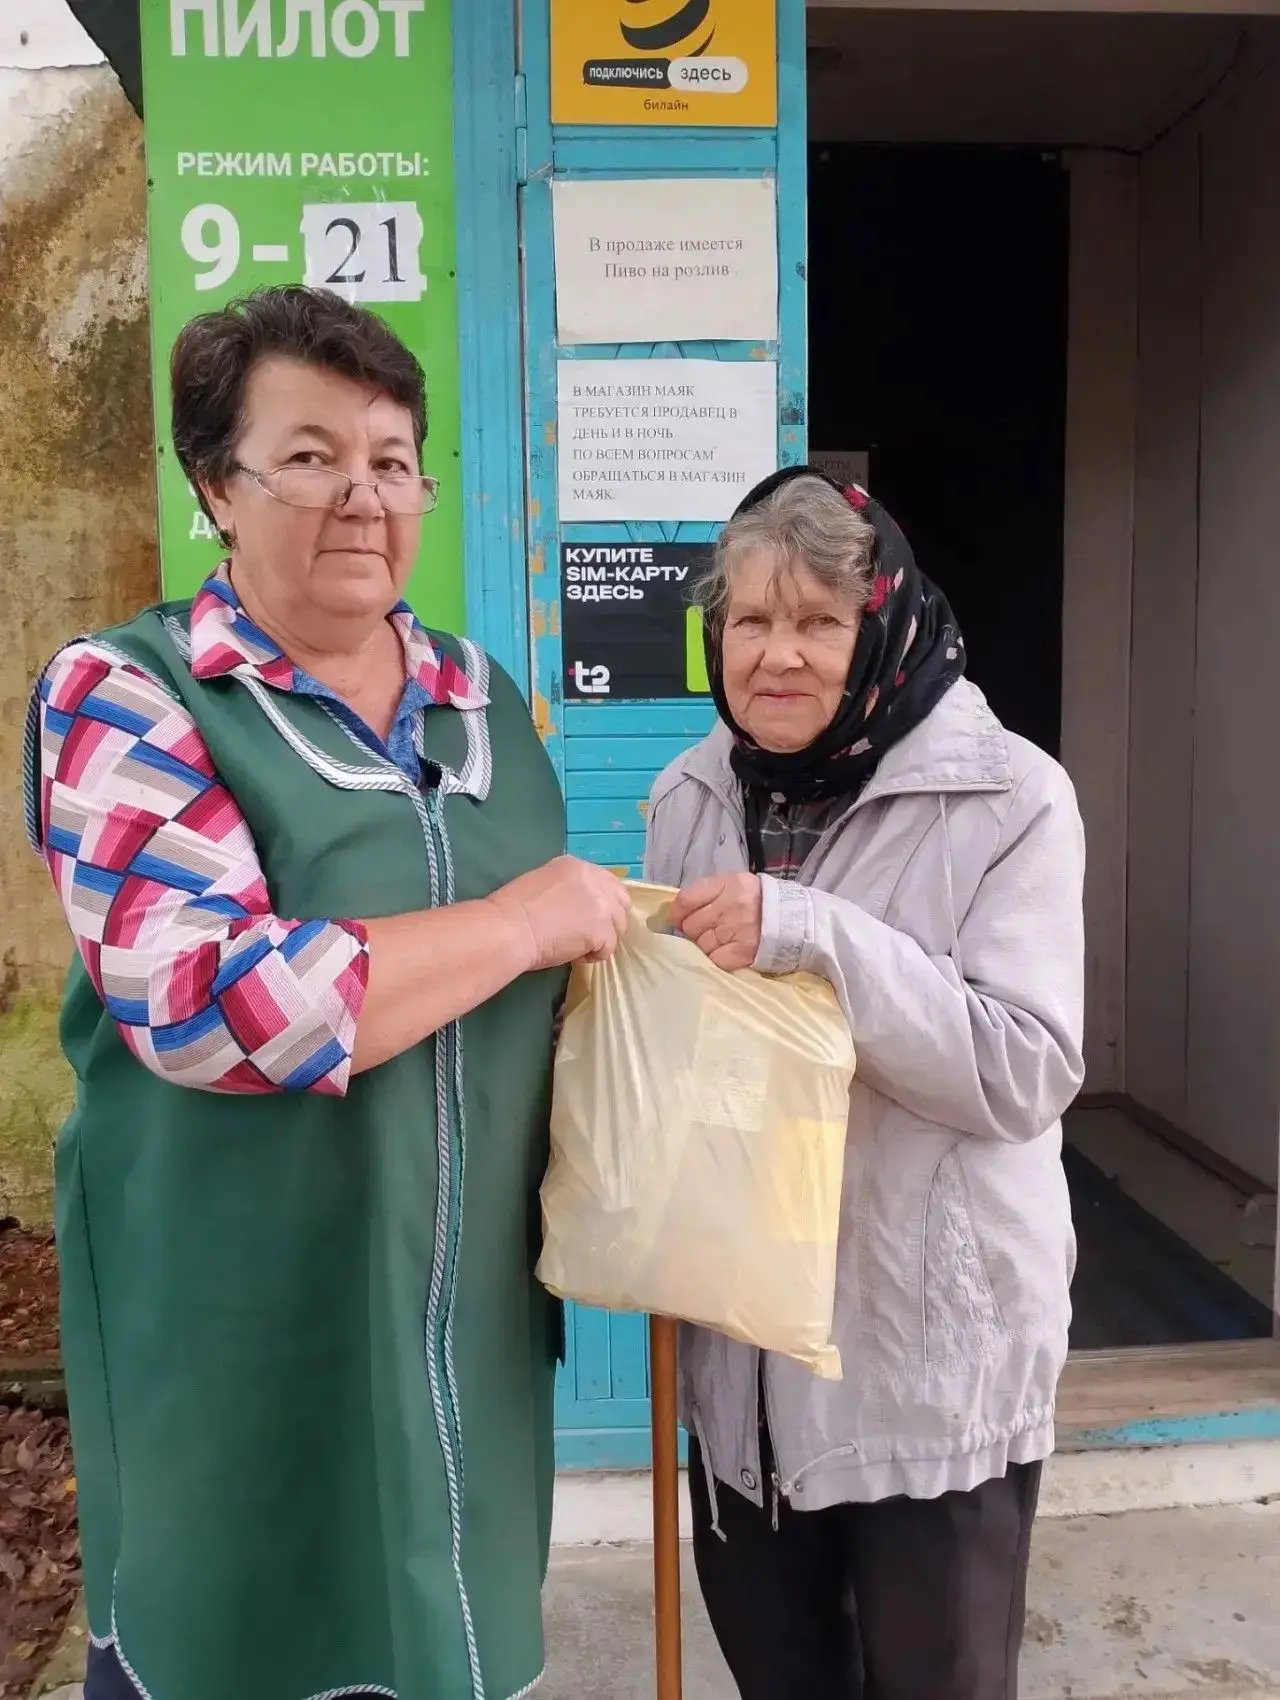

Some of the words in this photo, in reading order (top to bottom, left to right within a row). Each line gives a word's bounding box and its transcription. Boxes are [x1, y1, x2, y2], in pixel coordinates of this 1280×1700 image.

[169, 0, 426, 58] ПИЛОТ
[589, 66, 664, 81] подключись
[680, 66, 732, 83] здесь
[643, 98, 689, 111] билайн
[177, 152, 292, 177] РЕЖИМ
[301, 152, 430, 178] РАБОТЫ:
[589, 237, 601, 252] В
[606, 238, 675, 256] продаже
[680, 237, 744, 251] имеется
[604, 263, 647, 278] Пиво
[652, 264, 670, 278] на
[572, 386, 582, 396] В
[585, 385, 652, 397] МАГАЗИН
[655, 385, 696, 397] МАЯК
[573, 406, 650, 419] ТРЕБУЕТСЯ
[652, 406, 726, 420] ПРОДАВЕЦ
[729, 407, 738, 419] В
[572, 428, 608, 441] ДЕНЬ
[612, 428, 621, 439] И
[625, 428, 634, 439] В
[637, 428, 674, 440] НОЧЬ
[573, 449, 593, 461] ПО
[596, 449, 634, 461] ВСЕМ
[638, 449, 714, 461] ВОПРОСАМ
[572, 470, 666, 483] ОБРАЩАТЬСЯ
[669, 471, 678, 482] В
[681, 472, 746, 484] МАГАЗИН
[566, 548, 653, 563] КУПИТЕ
[566, 566, 689, 582] SIM-КАРТУ
[566, 585, 645, 602] ЗДЕСЬ
[574, 660, 611, 693] t2
